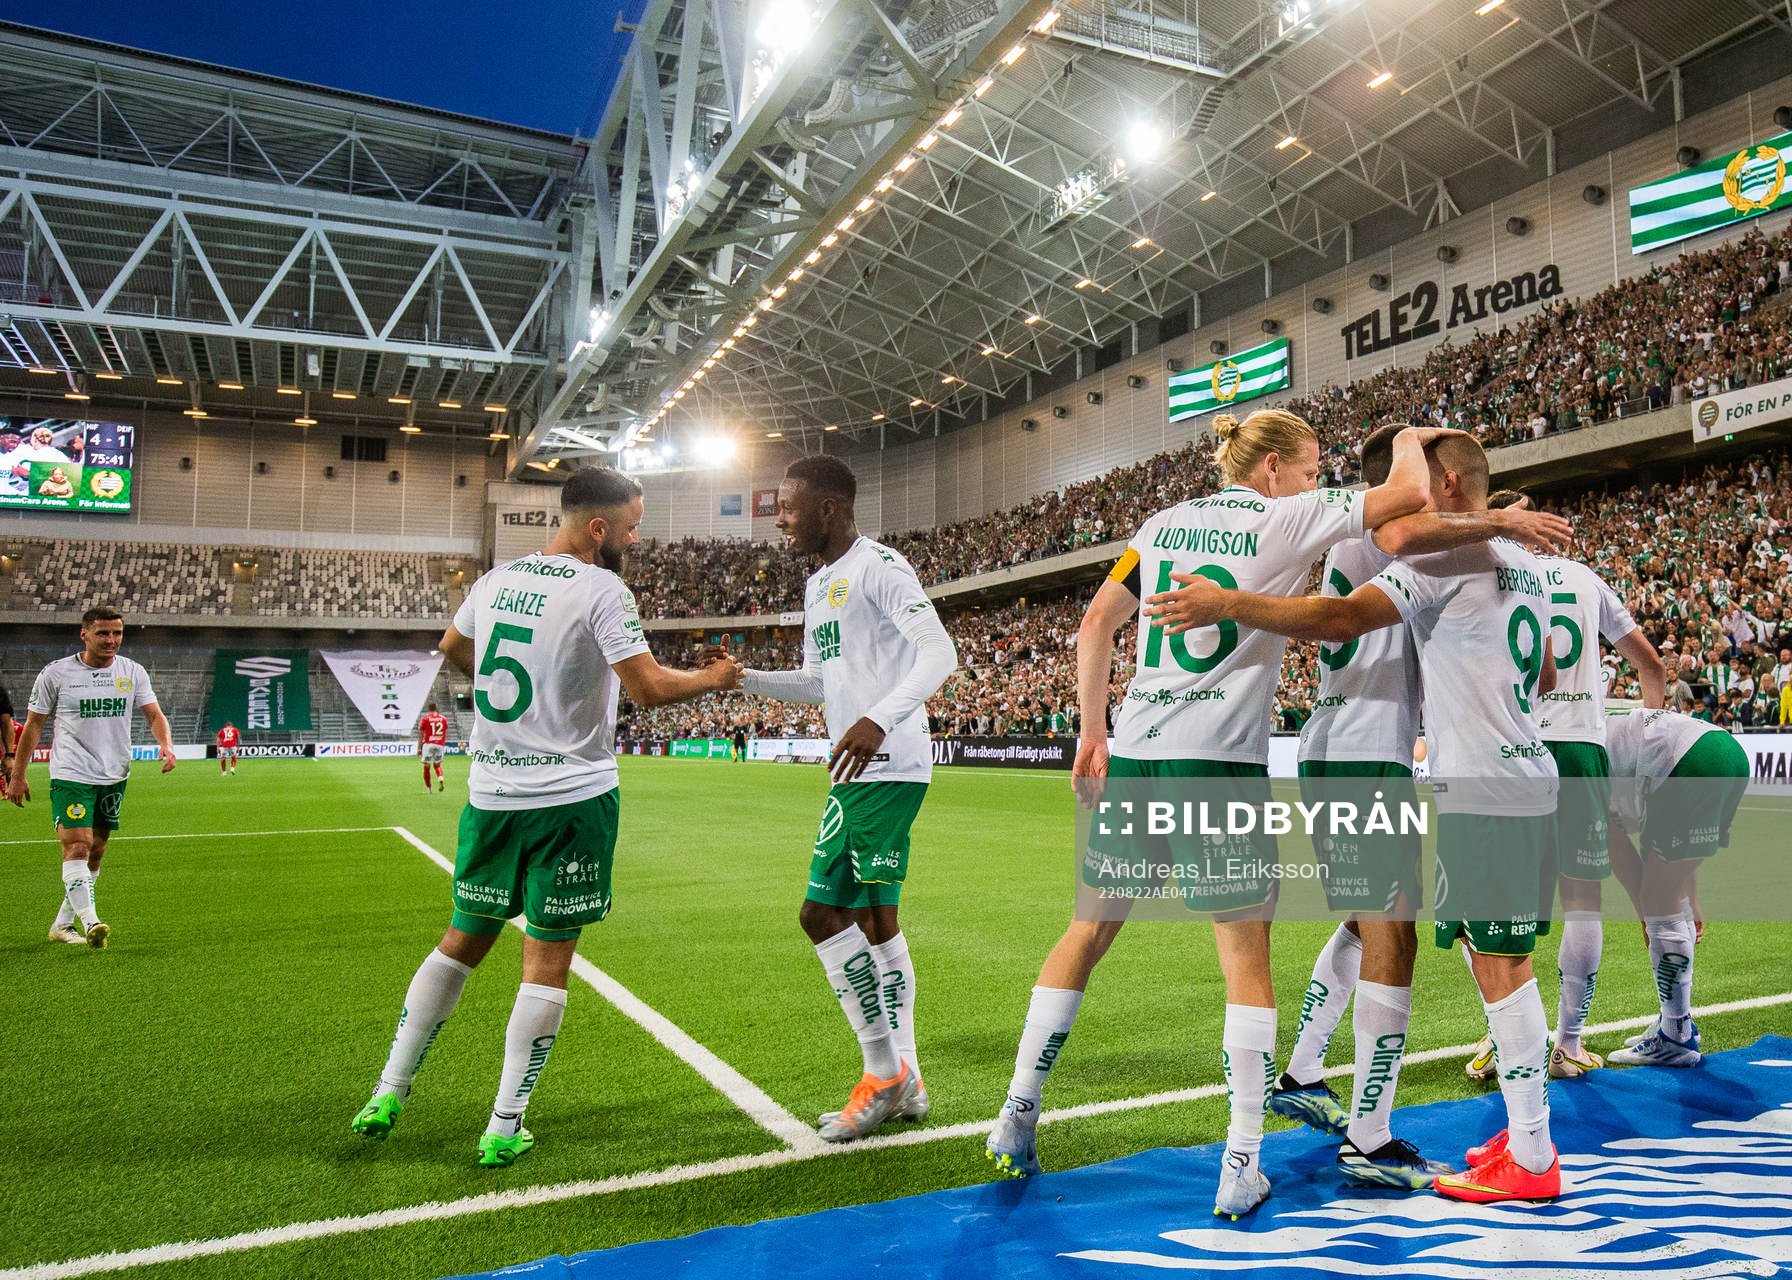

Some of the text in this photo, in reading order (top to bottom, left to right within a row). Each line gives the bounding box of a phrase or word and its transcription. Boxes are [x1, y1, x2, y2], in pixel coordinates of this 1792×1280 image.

[1341, 264, 1564, 361] TELE2 Arena
[1726, 402, 1753, 421] FÖR
[1757, 397, 1777, 413] EN
[90, 433, 101, 446] 4
[118, 435, 126, 447] 1
[90, 453, 124, 466] 75:41
[502, 511, 548, 527] TELE2
[1153, 526, 1259, 557] LUDWIGSON
[1495, 566, 1545, 599] BERISHA
[1546, 567, 1564, 586] IĆ
[490, 587, 548, 617] JEAHZE
[1507, 604, 1542, 714] 9
[475, 622, 533, 723] 5
[1541, 690, 1592, 702] pantbank
[80, 698, 127, 711] HUSKI
[80, 710, 125, 718] CHOCOLATE
[430, 722, 444, 735] 12
[332, 745, 414, 755] INTERSPORT
[964, 746, 1063, 762] Från råbetong till färdigt ytskikt
[500, 753, 566, 768] pantbank
[1203, 845, 1251, 859] STRÅLE
[556, 872, 599, 885] STRÅLE
[456, 880, 509, 897] PALLSERVICE
[1195, 879, 1259, 896] RENOVA AB
[1354, 886, 1370, 897] AB
[457, 888, 510, 906] RENOVA AB
[545, 891, 601, 905] PALLSERVICE
[543, 898, 602, 915] RENOVA AB
